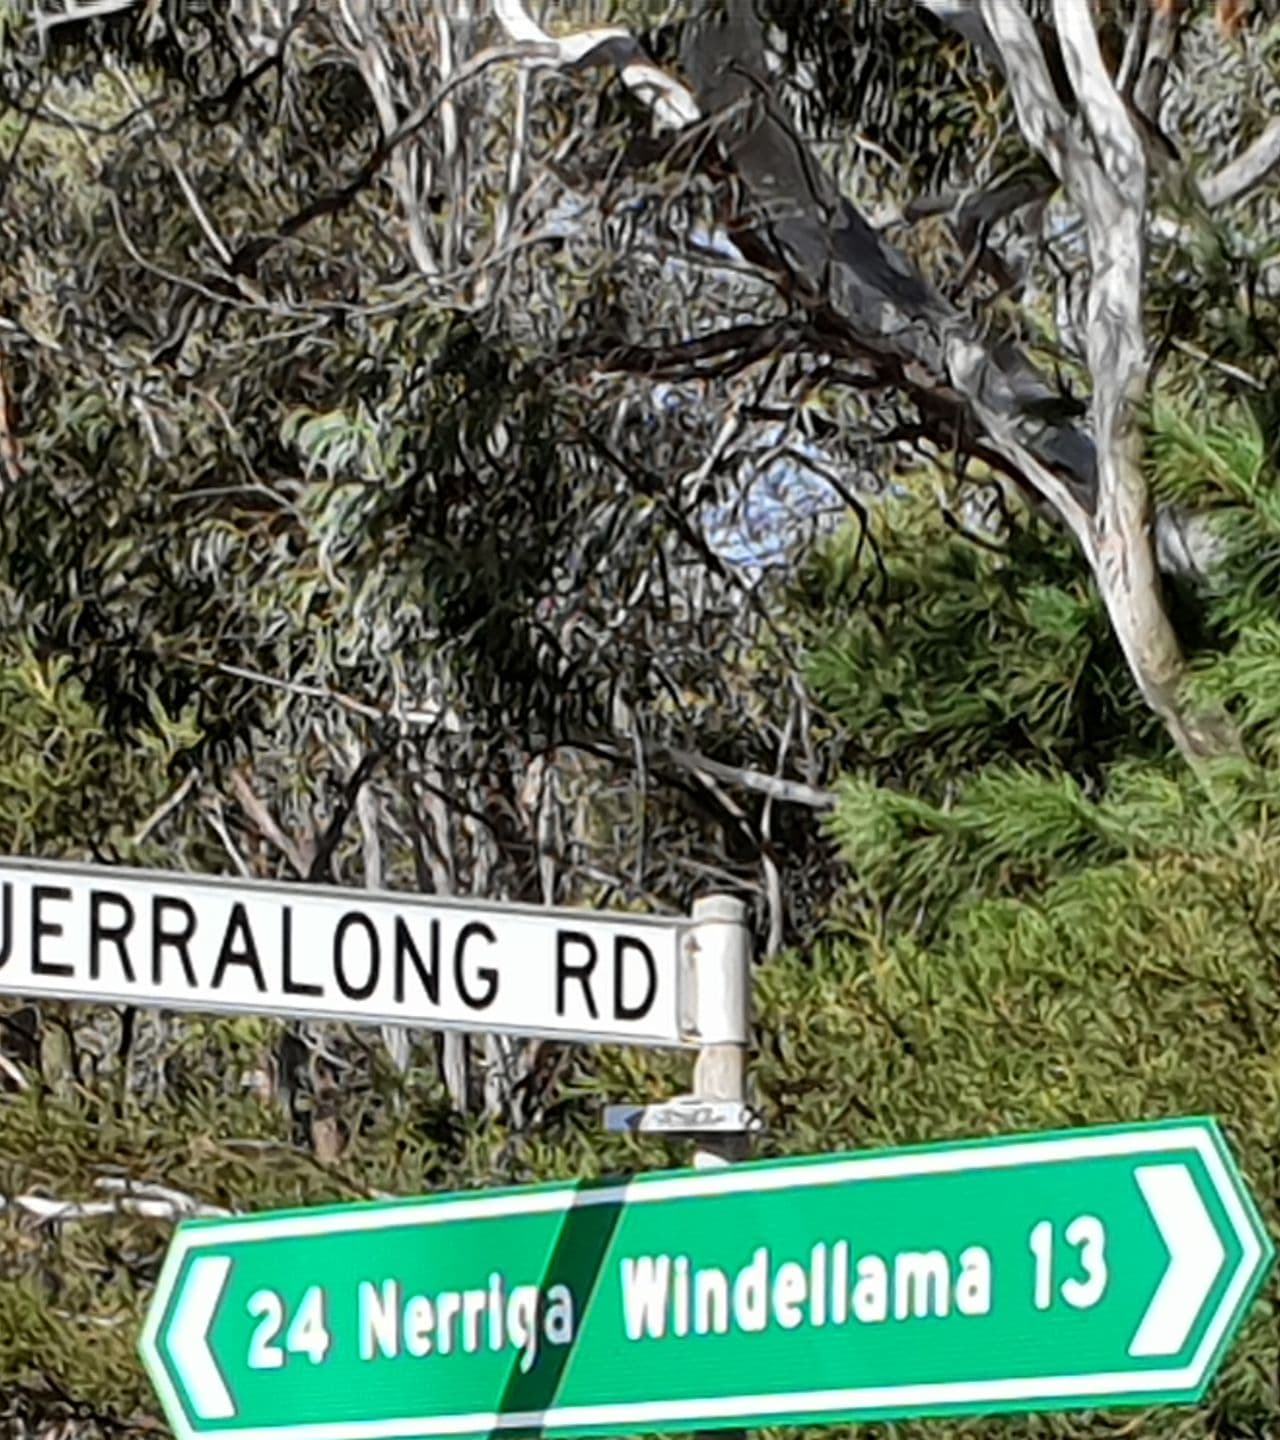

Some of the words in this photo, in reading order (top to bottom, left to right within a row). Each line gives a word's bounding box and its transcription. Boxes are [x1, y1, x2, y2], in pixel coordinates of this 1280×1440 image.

[555, 930, 658, 1021] RD
[246, 1286, 329, 1369] 24
[358, 1271, 574, 1374] Nerriga
[619, 1239, 992, 1341] Windellama
[1028, 1214, 1108, 1310] 13
